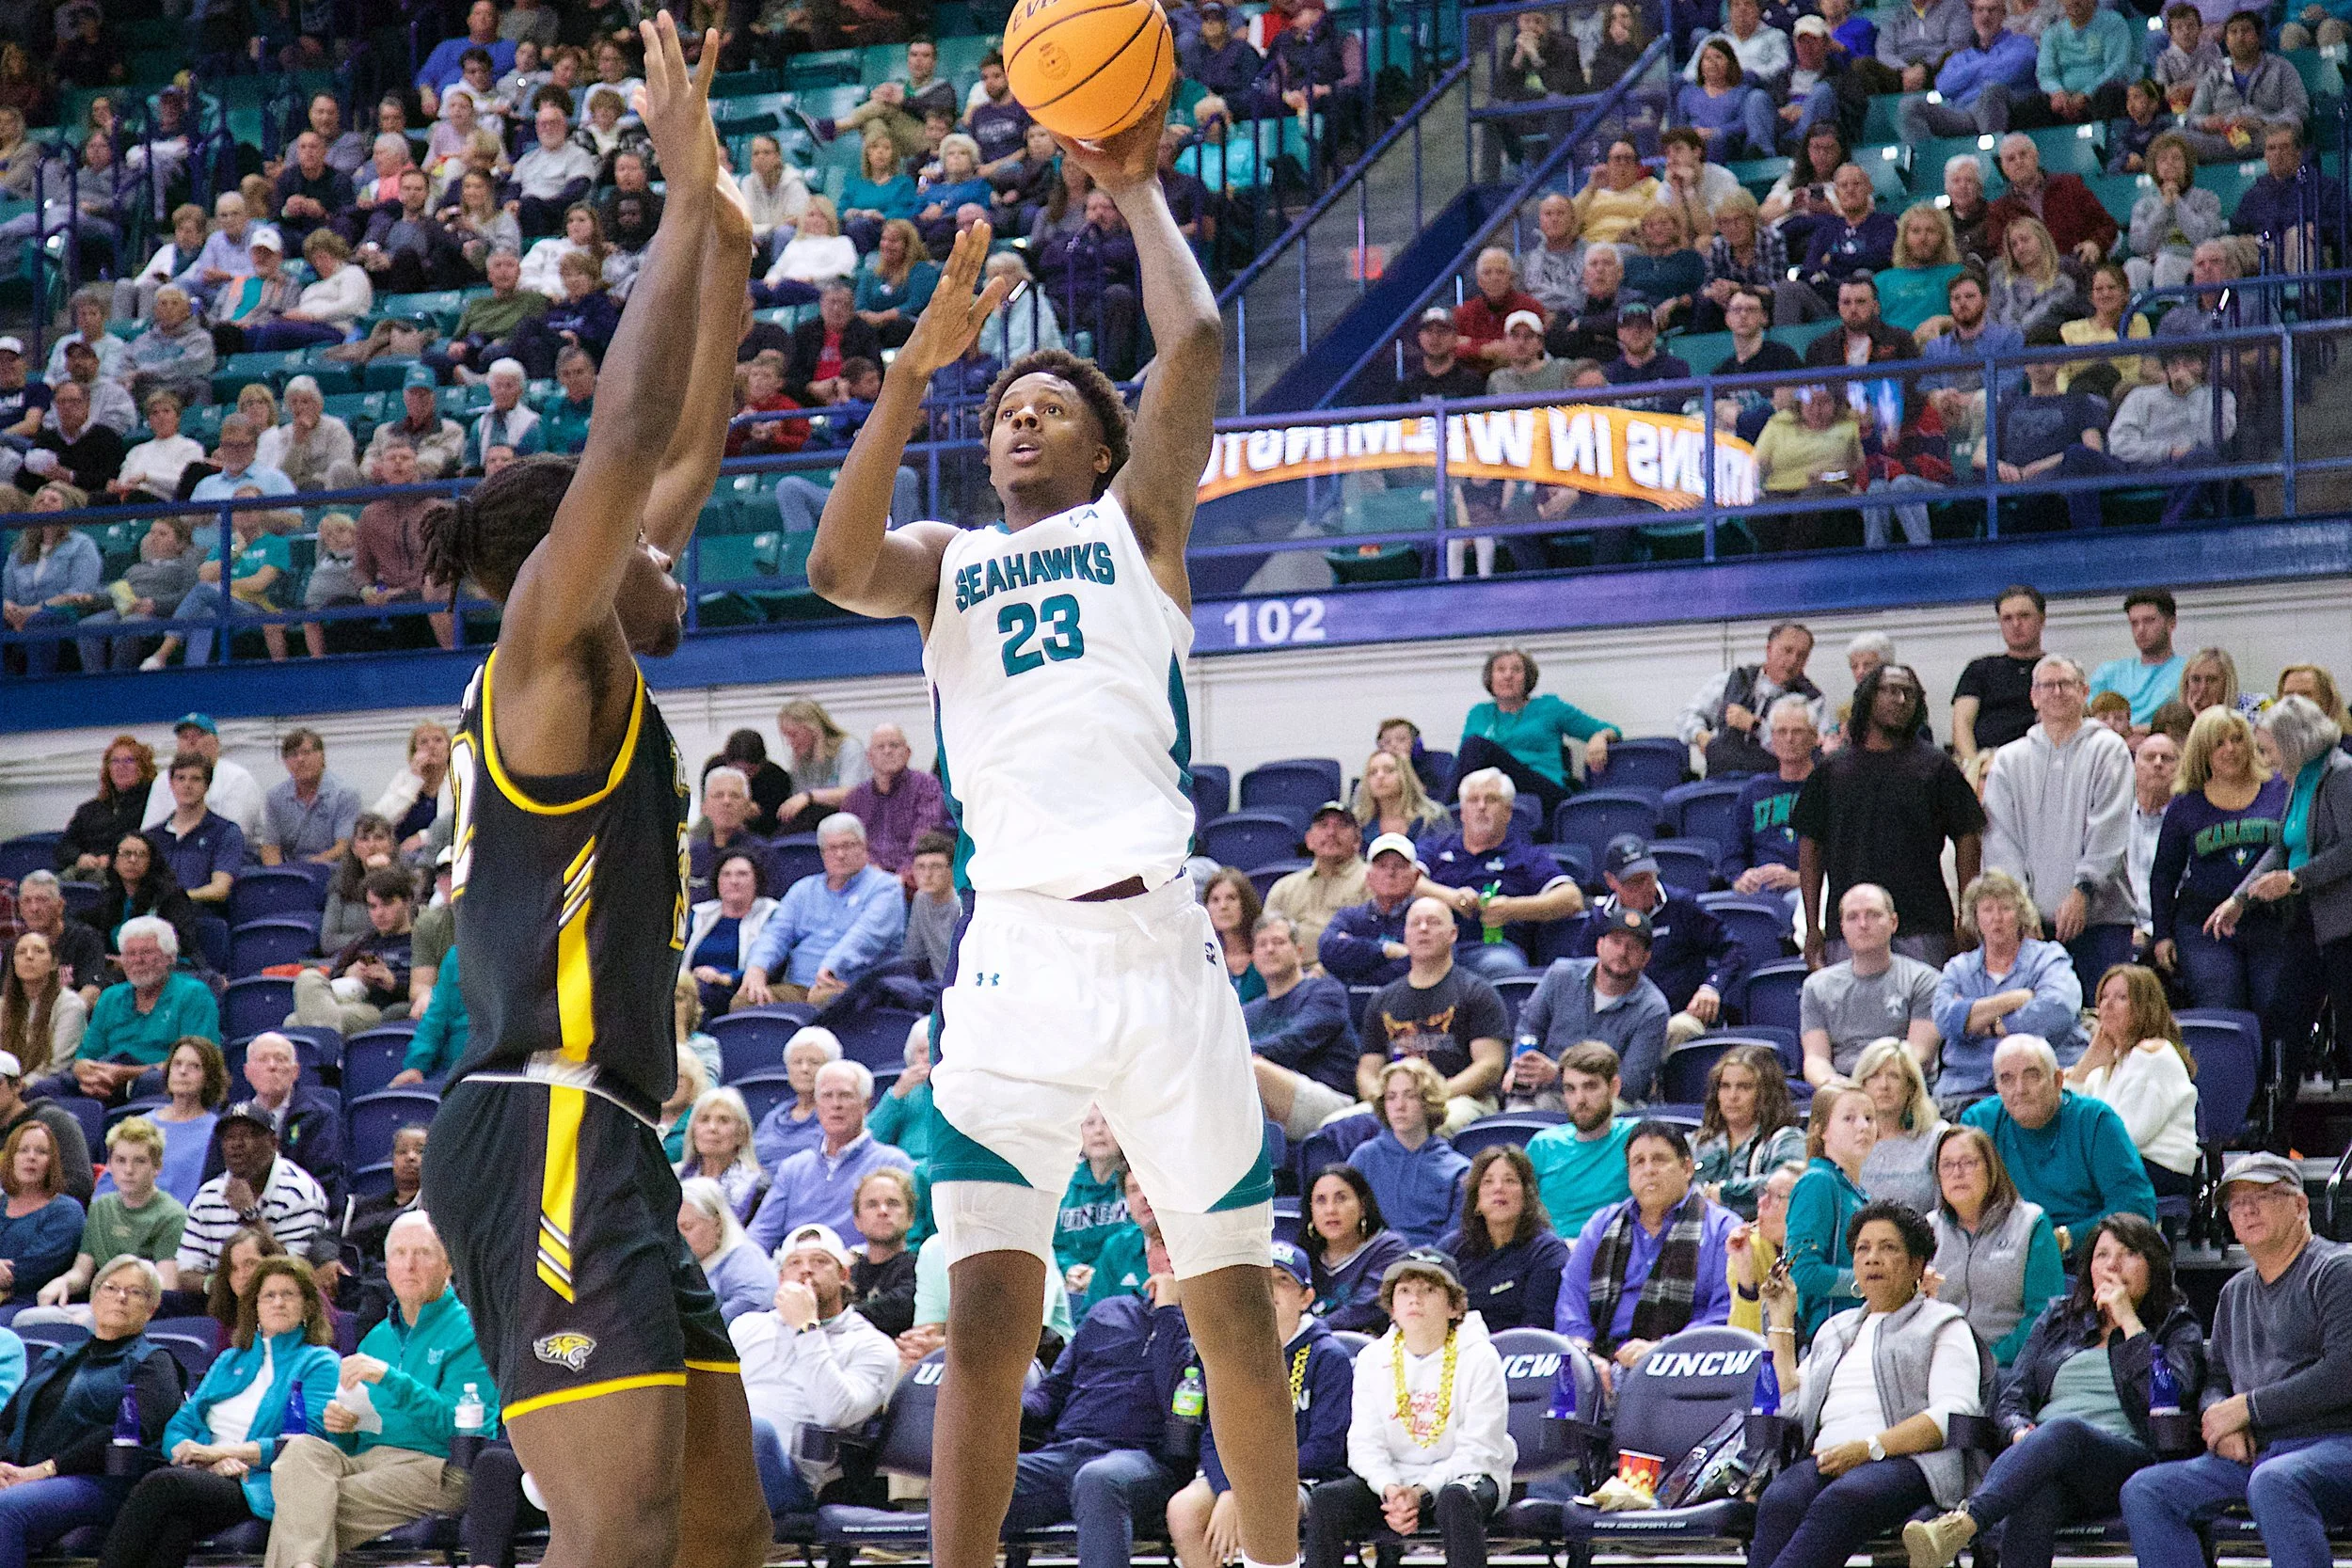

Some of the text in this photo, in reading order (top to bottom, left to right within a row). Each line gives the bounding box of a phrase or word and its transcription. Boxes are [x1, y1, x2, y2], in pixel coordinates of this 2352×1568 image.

[954, 542, 1116, 613] SEAHAWKS
[996, 594, 1085, 677] 23
[1224, 596, 1326, 647] 102
[1645, 1349, 1761, 1377] UNCW
